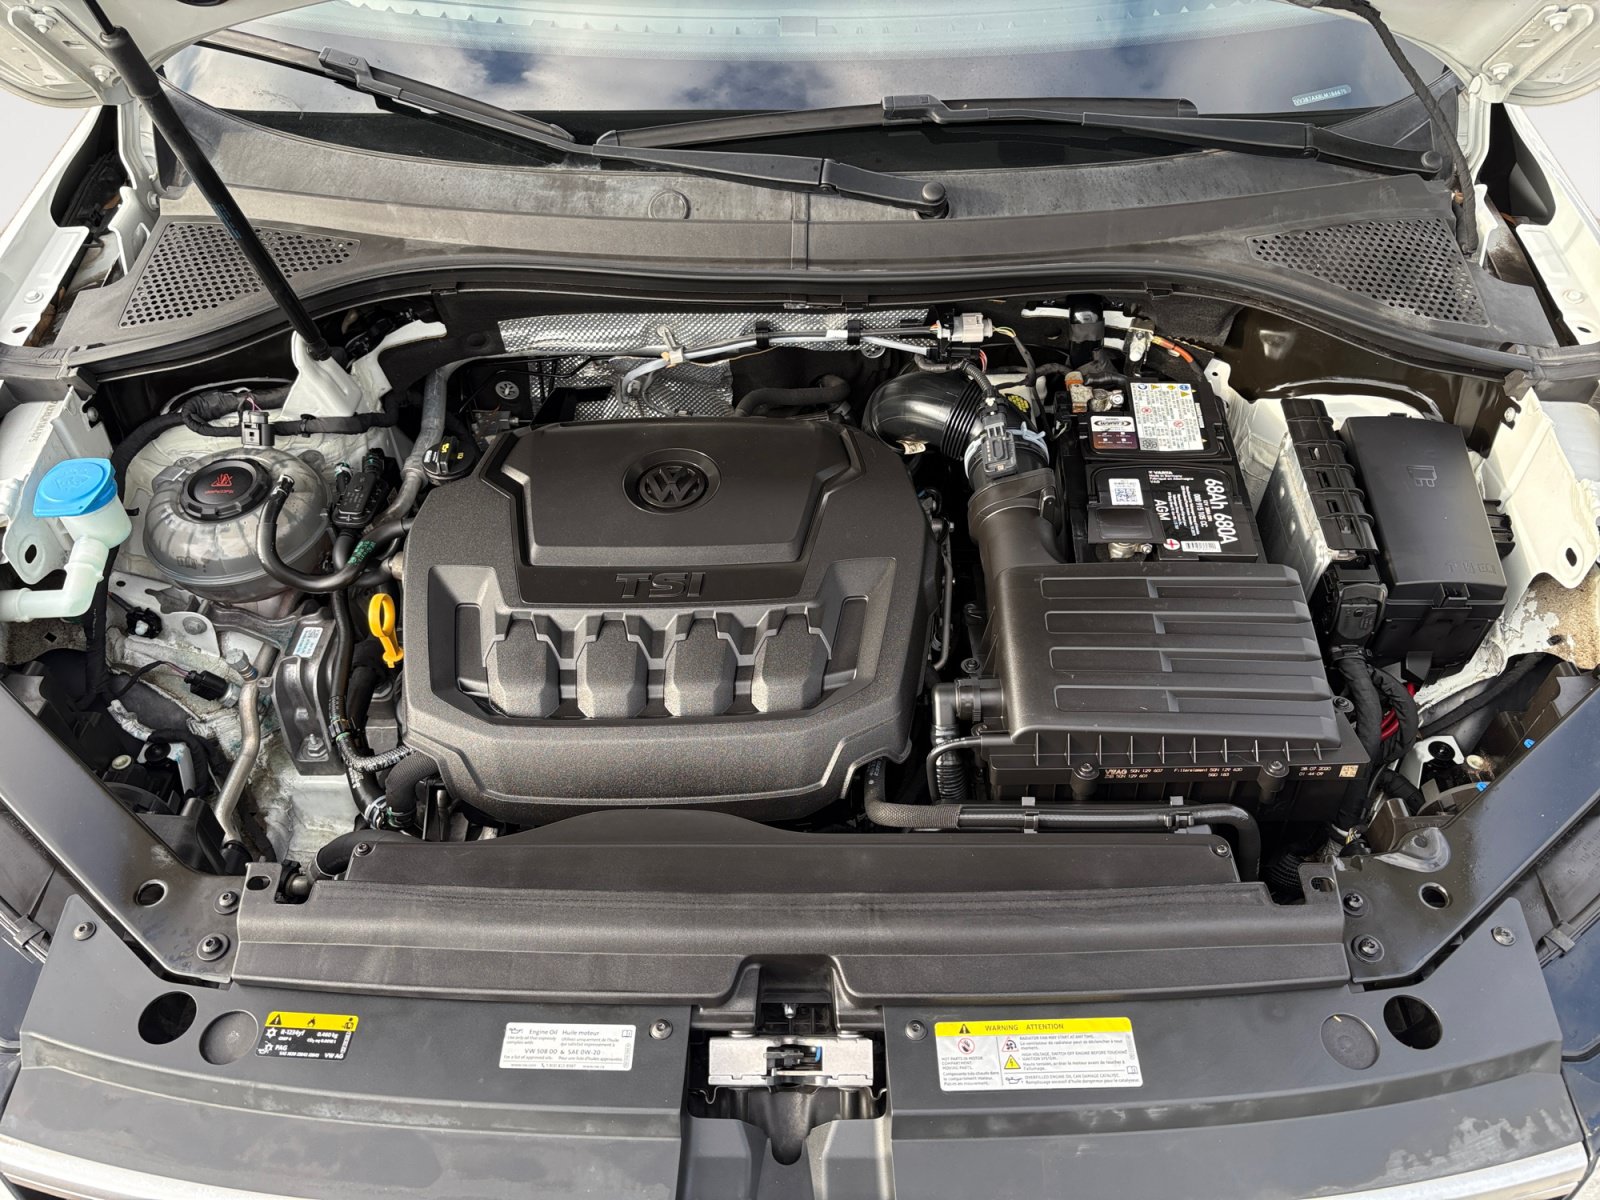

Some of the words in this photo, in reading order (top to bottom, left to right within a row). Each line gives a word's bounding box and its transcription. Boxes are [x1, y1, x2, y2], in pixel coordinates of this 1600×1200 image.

[1204, 478, 1228, 510] 68Ah
[1154, 499, 1171, 520] AGM
[1214, 513, 1238, 544] 680A
[616, 572, 706, 598] TSI
